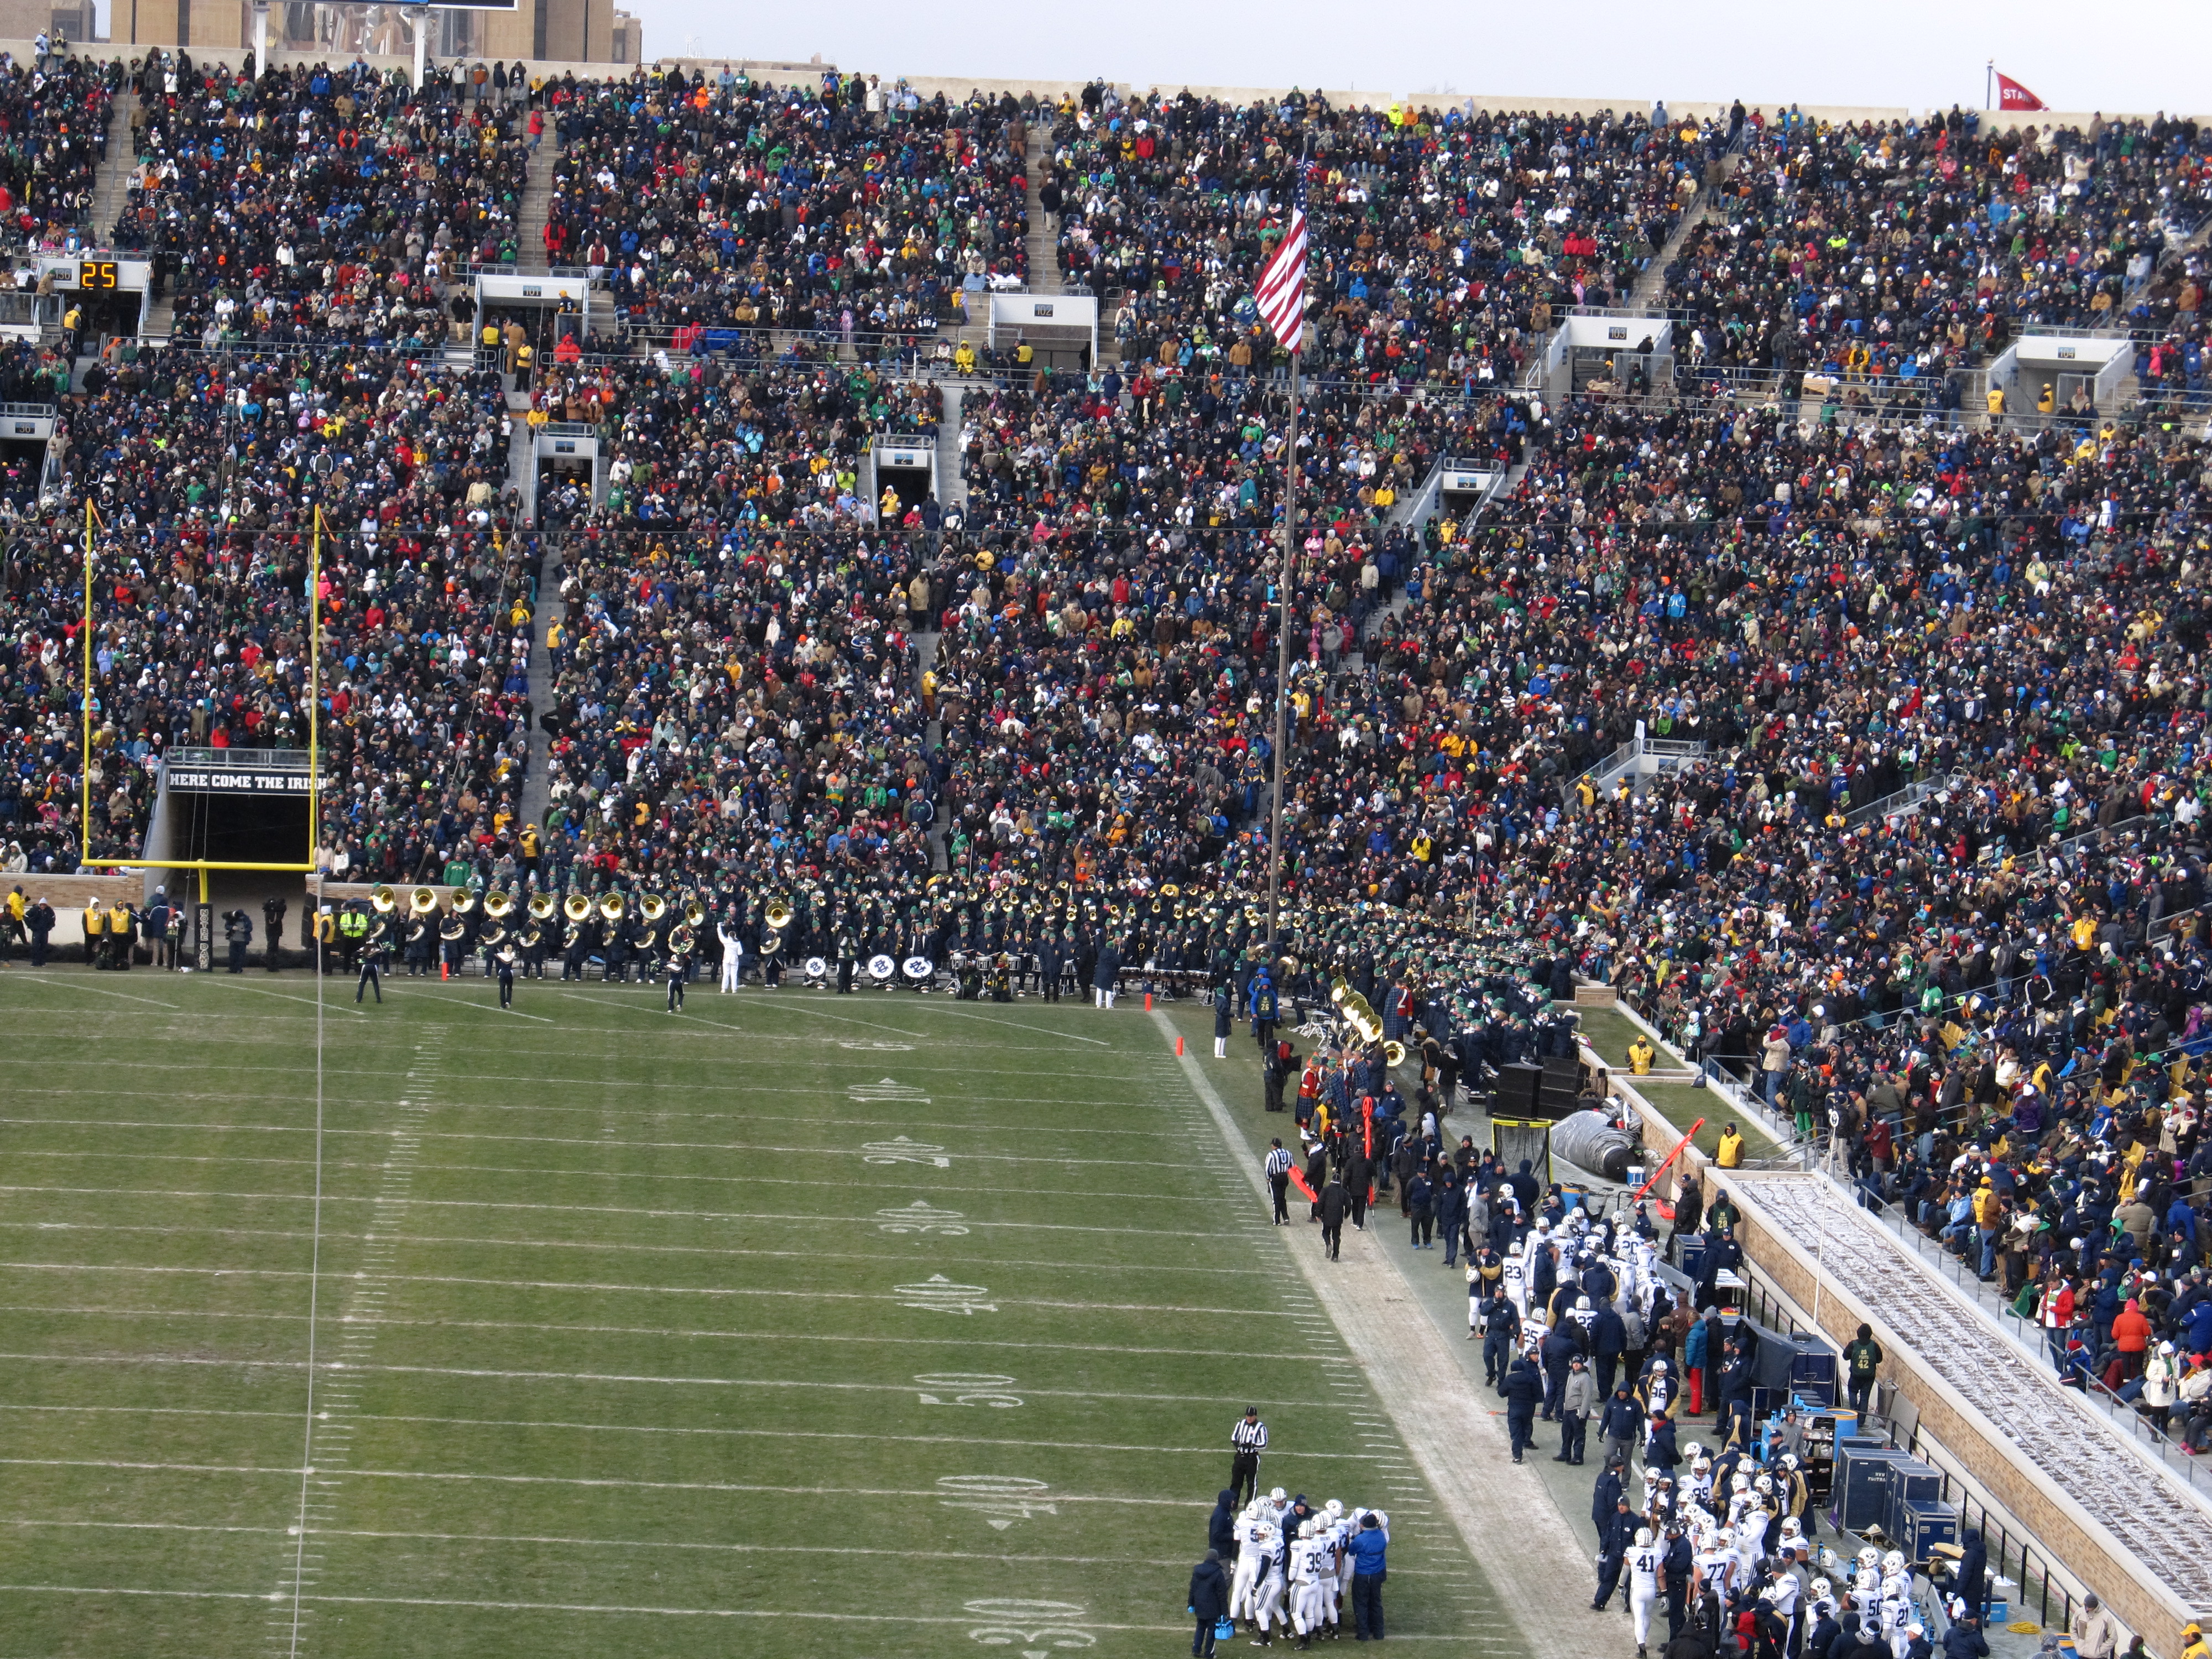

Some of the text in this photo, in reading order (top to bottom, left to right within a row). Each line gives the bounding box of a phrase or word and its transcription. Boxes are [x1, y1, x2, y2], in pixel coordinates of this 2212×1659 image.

[82, 263, 115, 288] 25
[526, 285, 539, 296] 101
[1037, 305, 1051, 316] 102
[1611, 328, 1626, 339] 103
[2060, 348, 2074, 358] 104
[901, 454, 907, 464] 2
[170, 774, 208, 786] HERE
[211, 775, 251, 789] COME
[255, 776, 284, 789] THE
[200, 909, 209, 941] NOTRE
[875, 1208, 970, 1235] 30
[1563, 1244, 1575, 1259] 45
[1505, 1265, 1522, 1279] 23
[894, 1283, 999, 1315] 40
[1524, 1327, 1539, 1345] 25
[1858, 1359, 1869, 1369] 42
[914, 1373, 1024, 1408] 50
[936, 1475, 1058, 1519] 40
[1306, 1552, 1322, 1573] 39
[1636, 1554, 1655, 1572] 41
[1707, 1562, 1727, 1581] 77
[963, 1598, 1097, 1648] 30
[1896, 1606, 1909, 1627] 21
